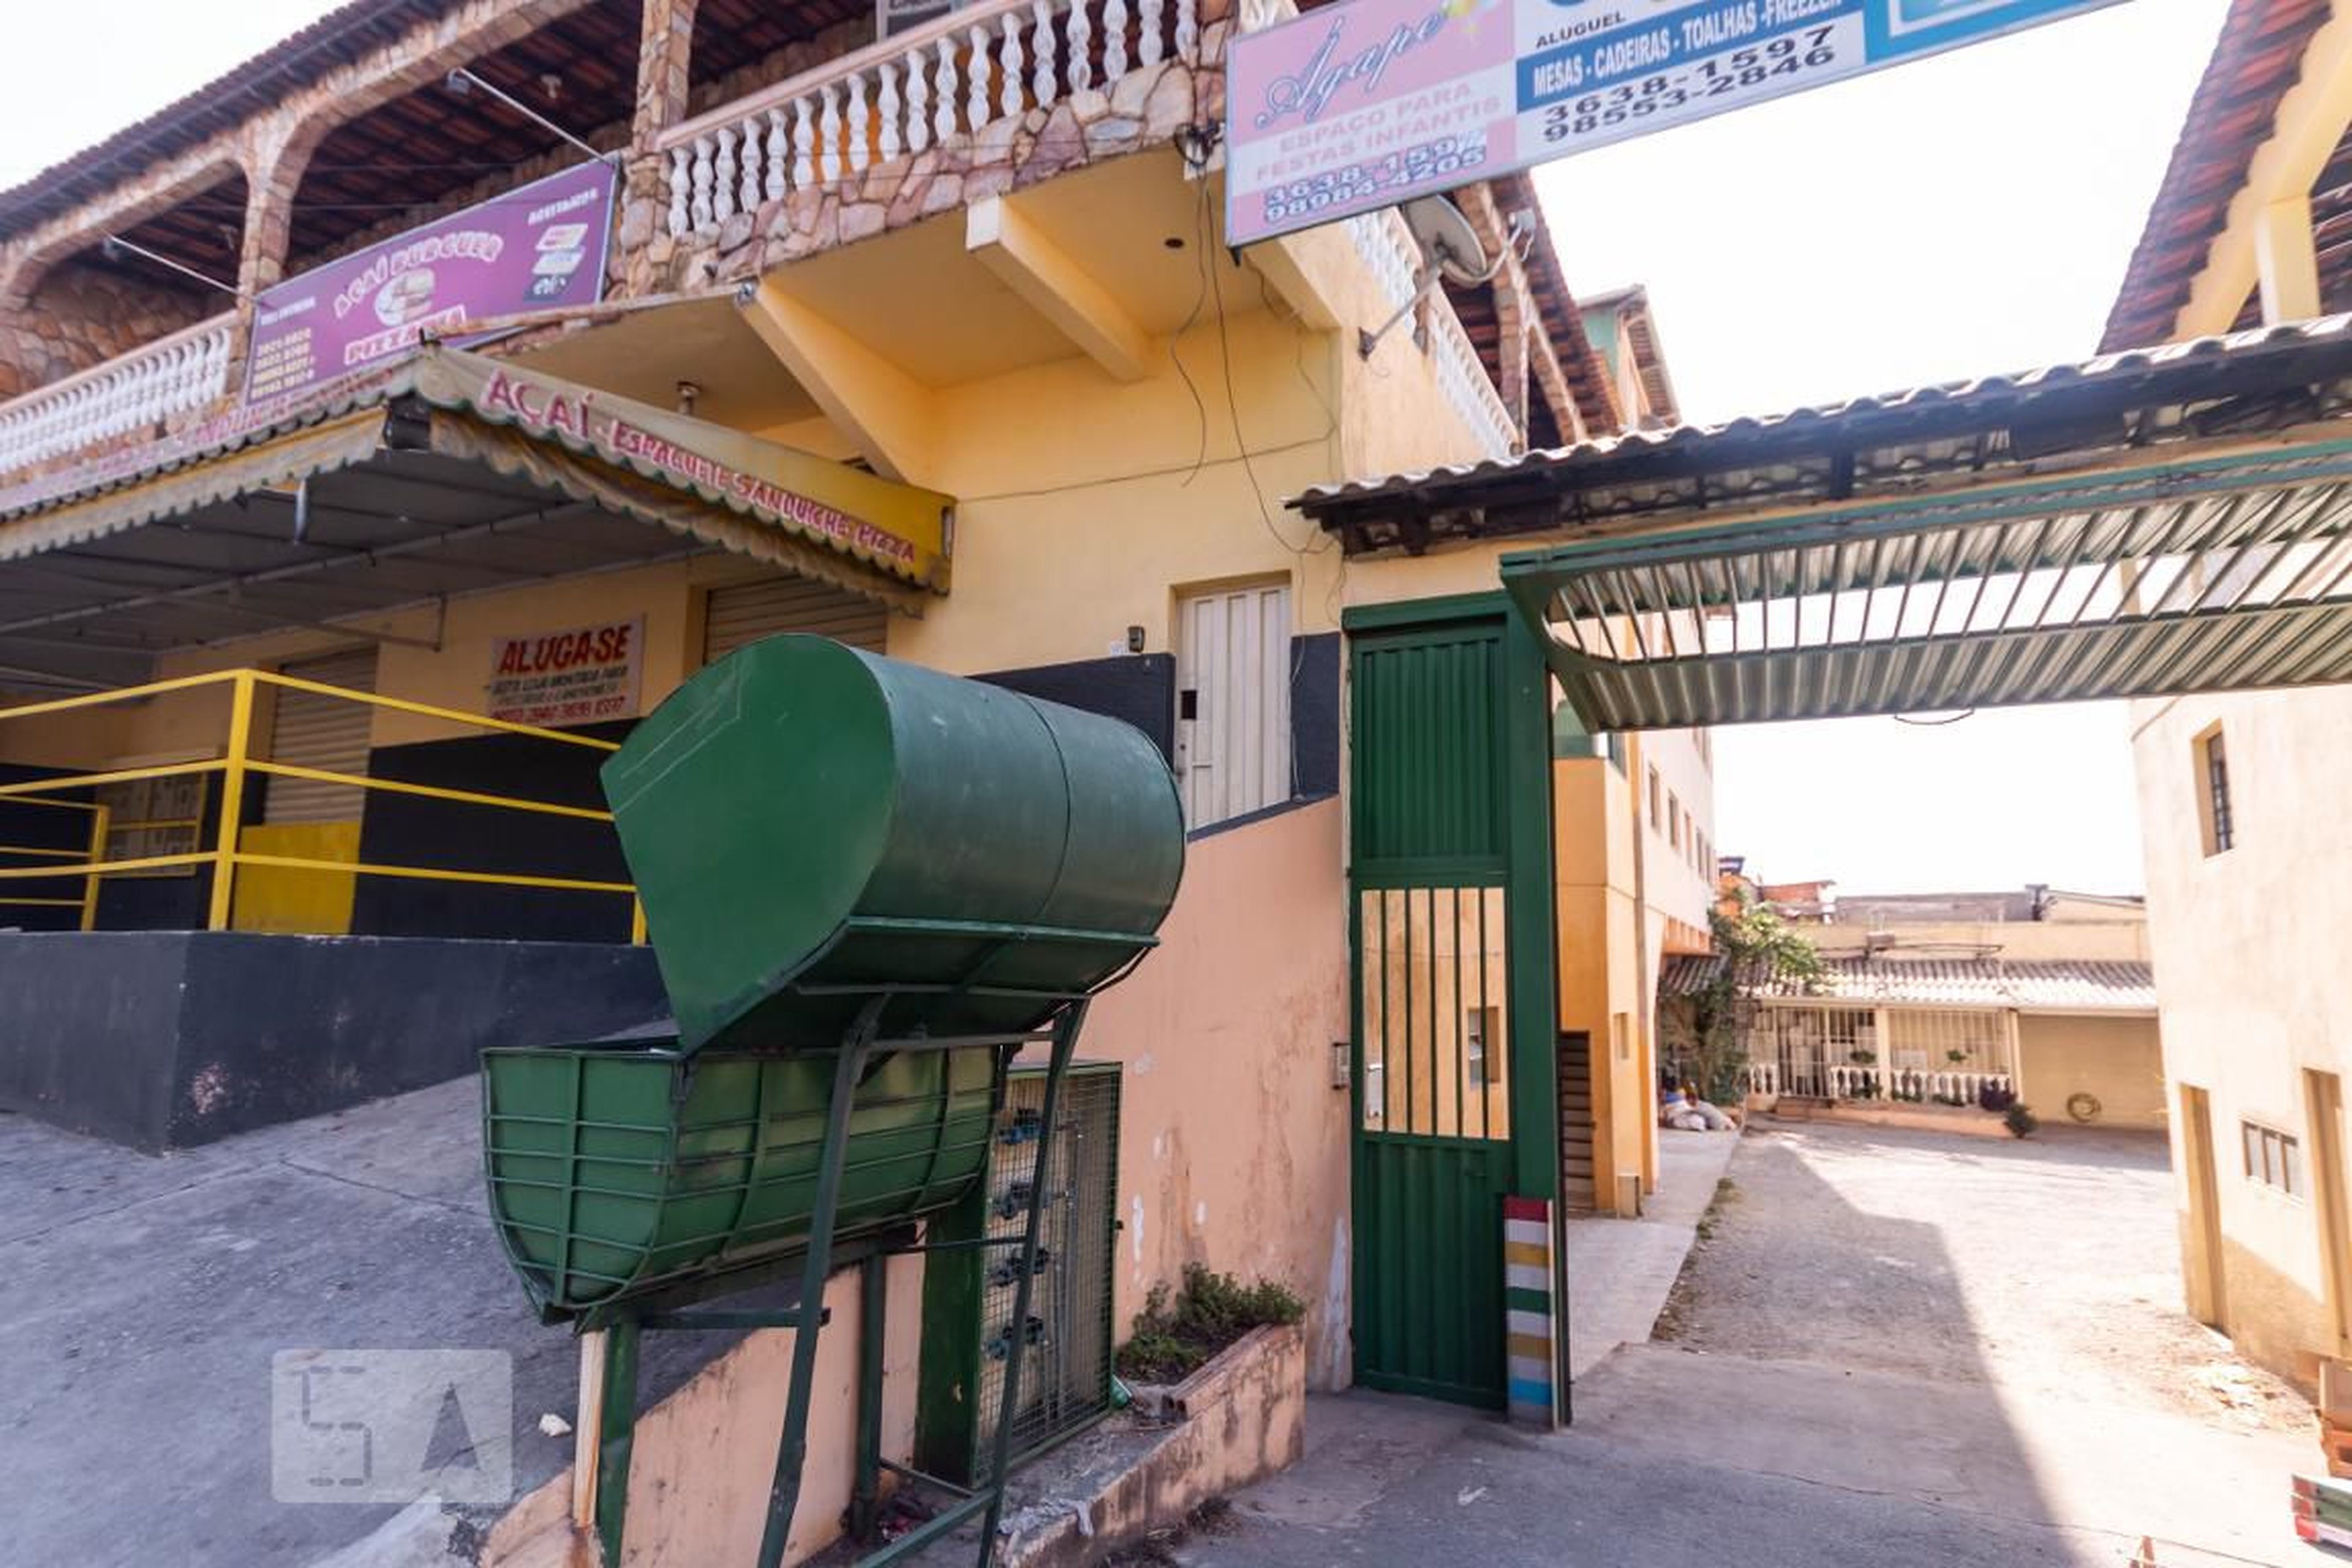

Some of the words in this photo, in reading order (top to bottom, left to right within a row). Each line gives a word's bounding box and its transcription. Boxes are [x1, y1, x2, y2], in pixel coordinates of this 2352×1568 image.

[1534, 54, 1583, 97] MESAS
[1594, 27, 1670, 79] CADEIRAS
[1681, 1, 1757, 51] TOALHAS
[1536, 10, 1626, 48] ALUGUEL
[1545, 24, 1834, 124] 3638-1597
[1256, 139, 1356, 181] FESTAS
[1365, 96, 1502, 149] INFANTIS
[1396, 83, 1471, 117] PARA
[1544, 46, 1835, 142] 98553-2846
